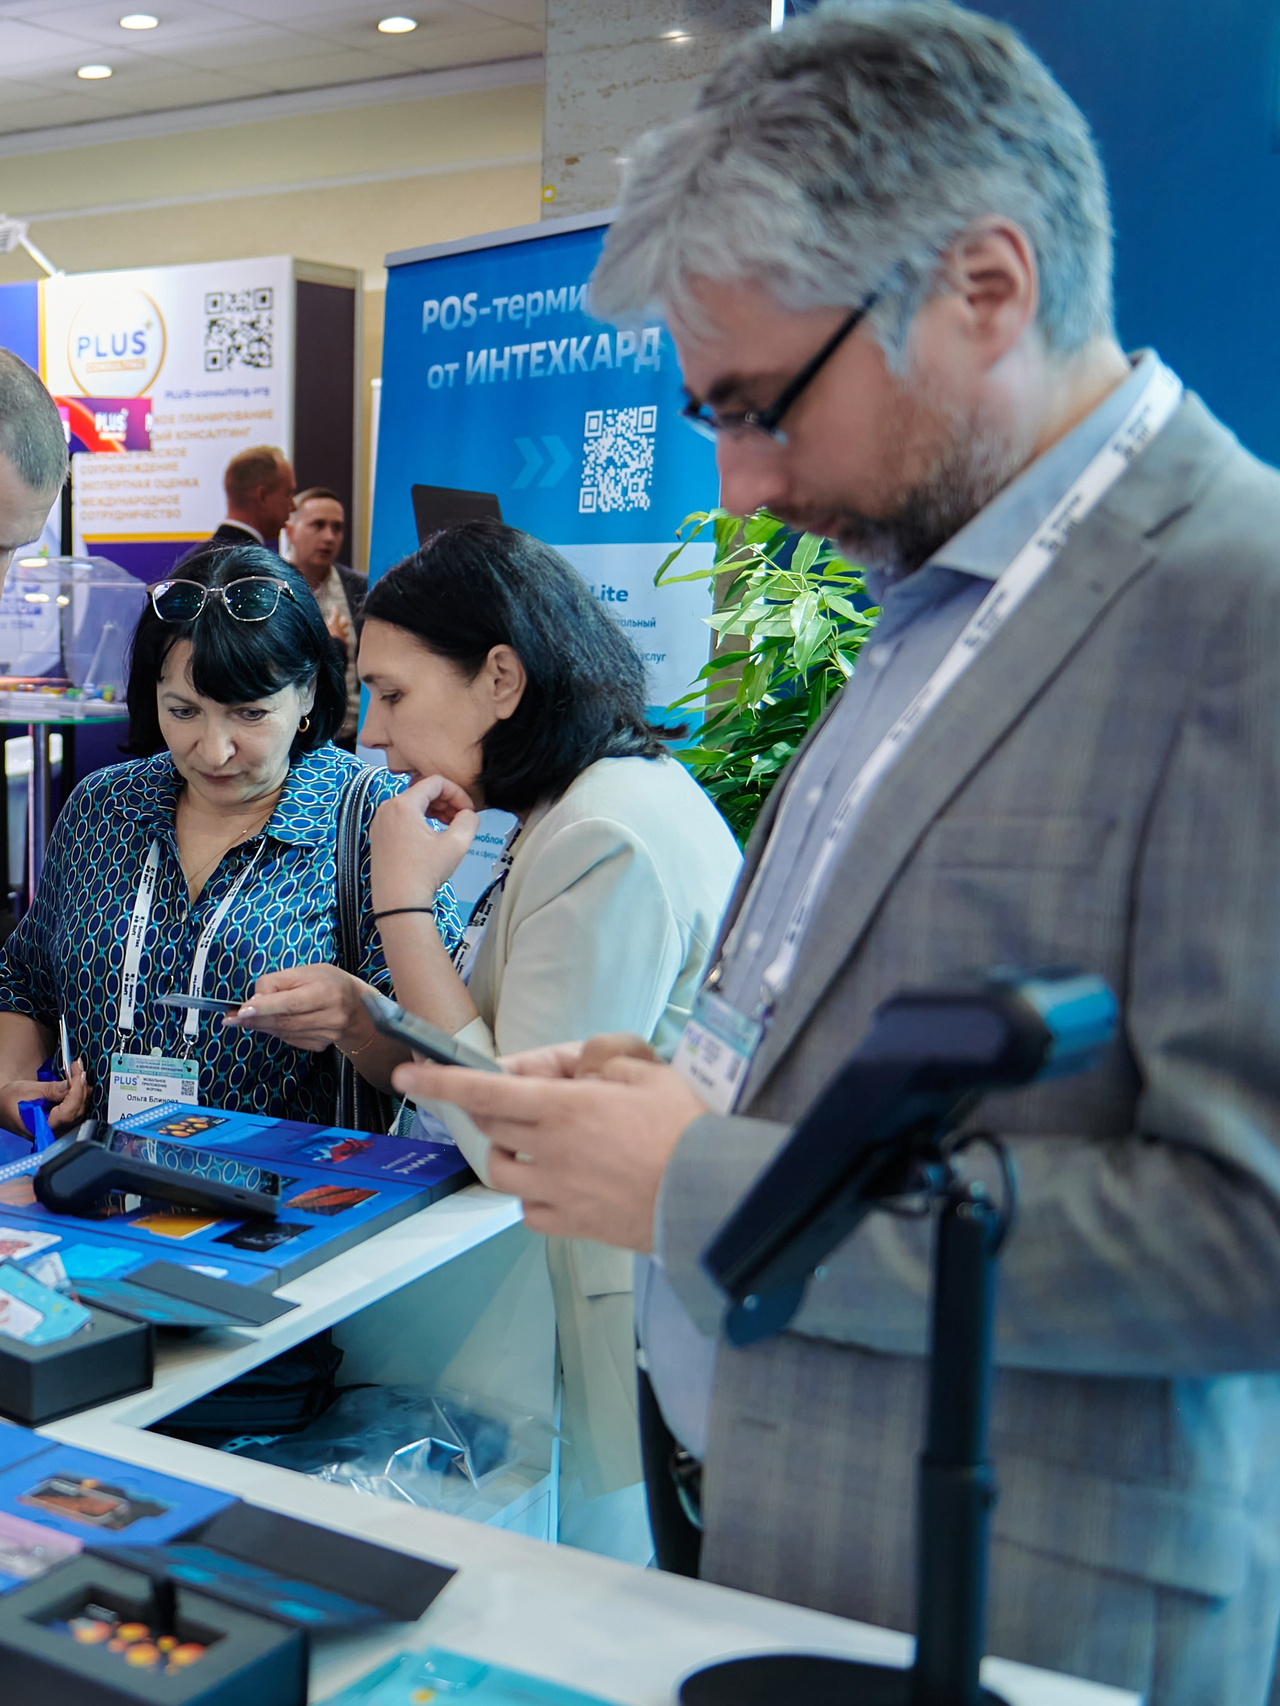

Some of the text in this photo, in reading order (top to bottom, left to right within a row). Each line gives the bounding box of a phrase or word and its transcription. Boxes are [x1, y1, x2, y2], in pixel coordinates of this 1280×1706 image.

[422, 284, 591, 333] POS-терми
[78, 330, 147, 358] PLUS
[427, 326, 662, 390] от ИНТЕХКАРД
[179, 408, 274, 423] ПЛАНИРОВАНИЕ
[175, 426, 251, 440] КОНСАЛТИНГ
[80, 461, 179, 475] СОПРОВОЖДЕНИЕ
[80, 494, 180, 507] МЕЖДУНАРОДНОЕ
[618, 616, 657, 628] ольный
[473, 833, 505, 845] ноблок
[114, 1076, 138, 1086] PLUS
[126, 1093, 148, 1103] Ольга
